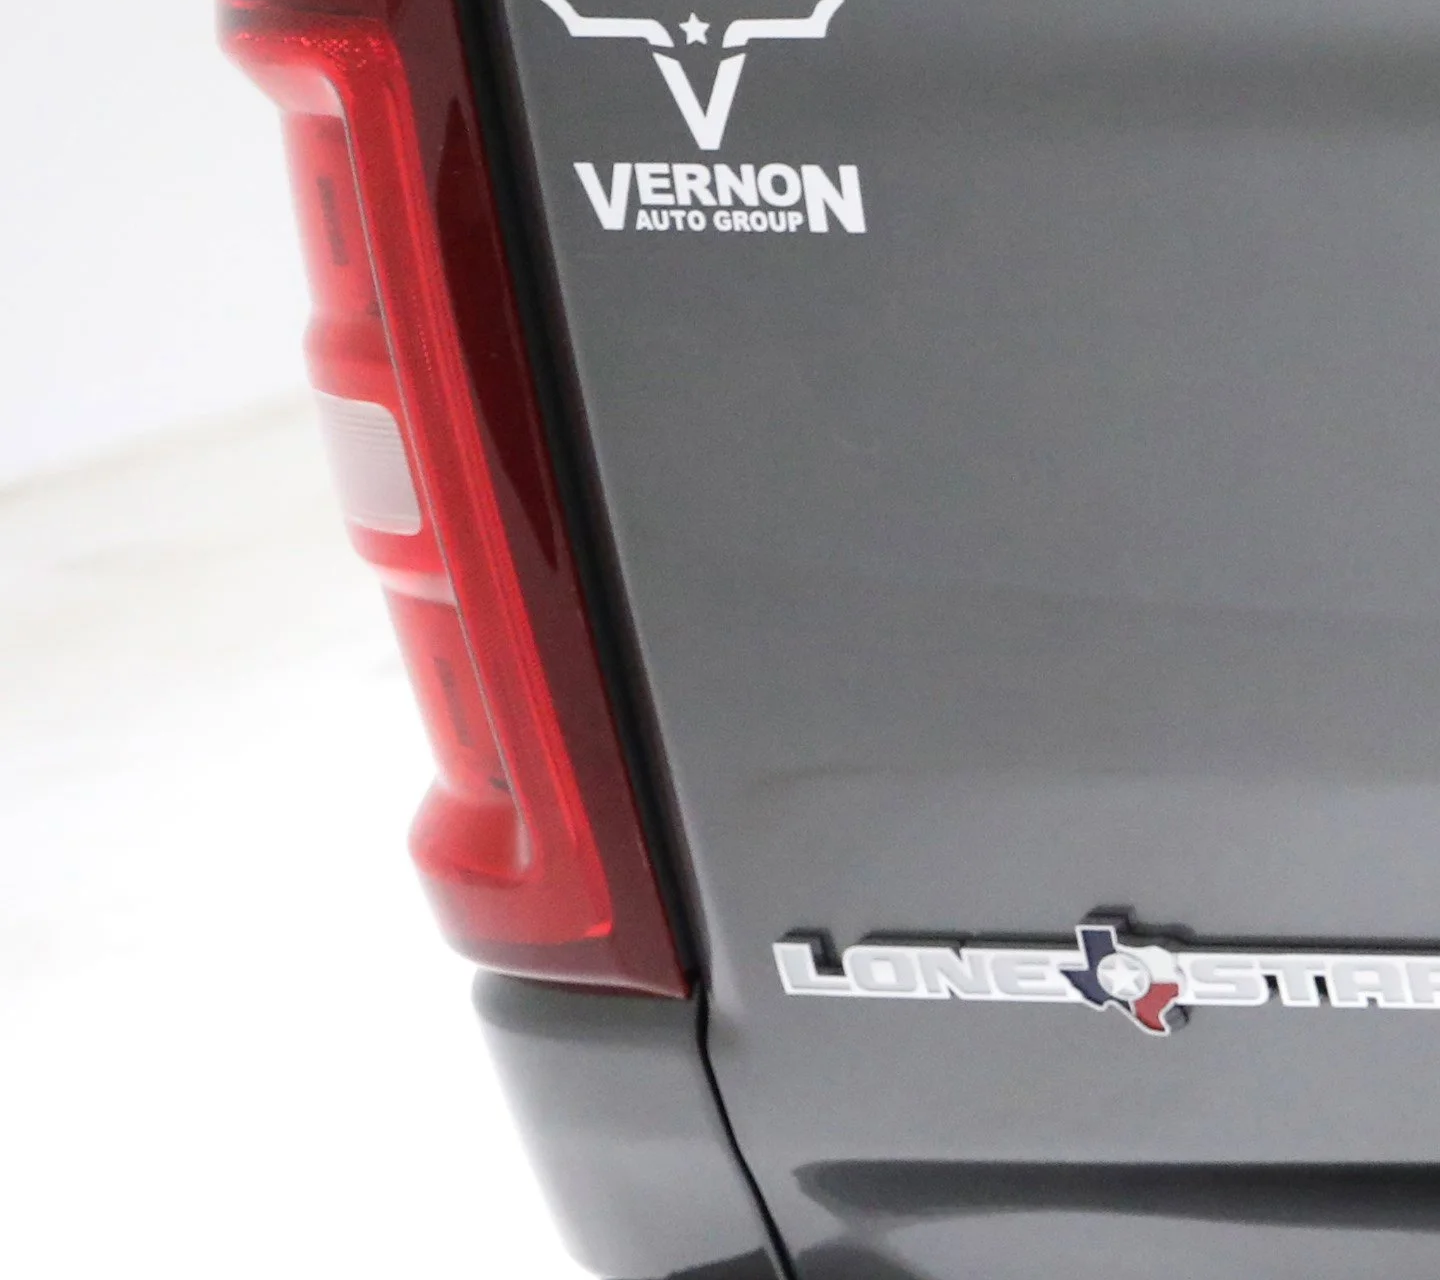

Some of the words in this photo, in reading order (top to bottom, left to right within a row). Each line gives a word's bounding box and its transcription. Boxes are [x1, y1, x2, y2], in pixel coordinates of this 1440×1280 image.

[573, 161, 867, 234] VERNON
[635, 209, 707, 232] AUTO
[713, 209, 805, 232] GROUP
[772, 942, 1080, 1001] LONE
